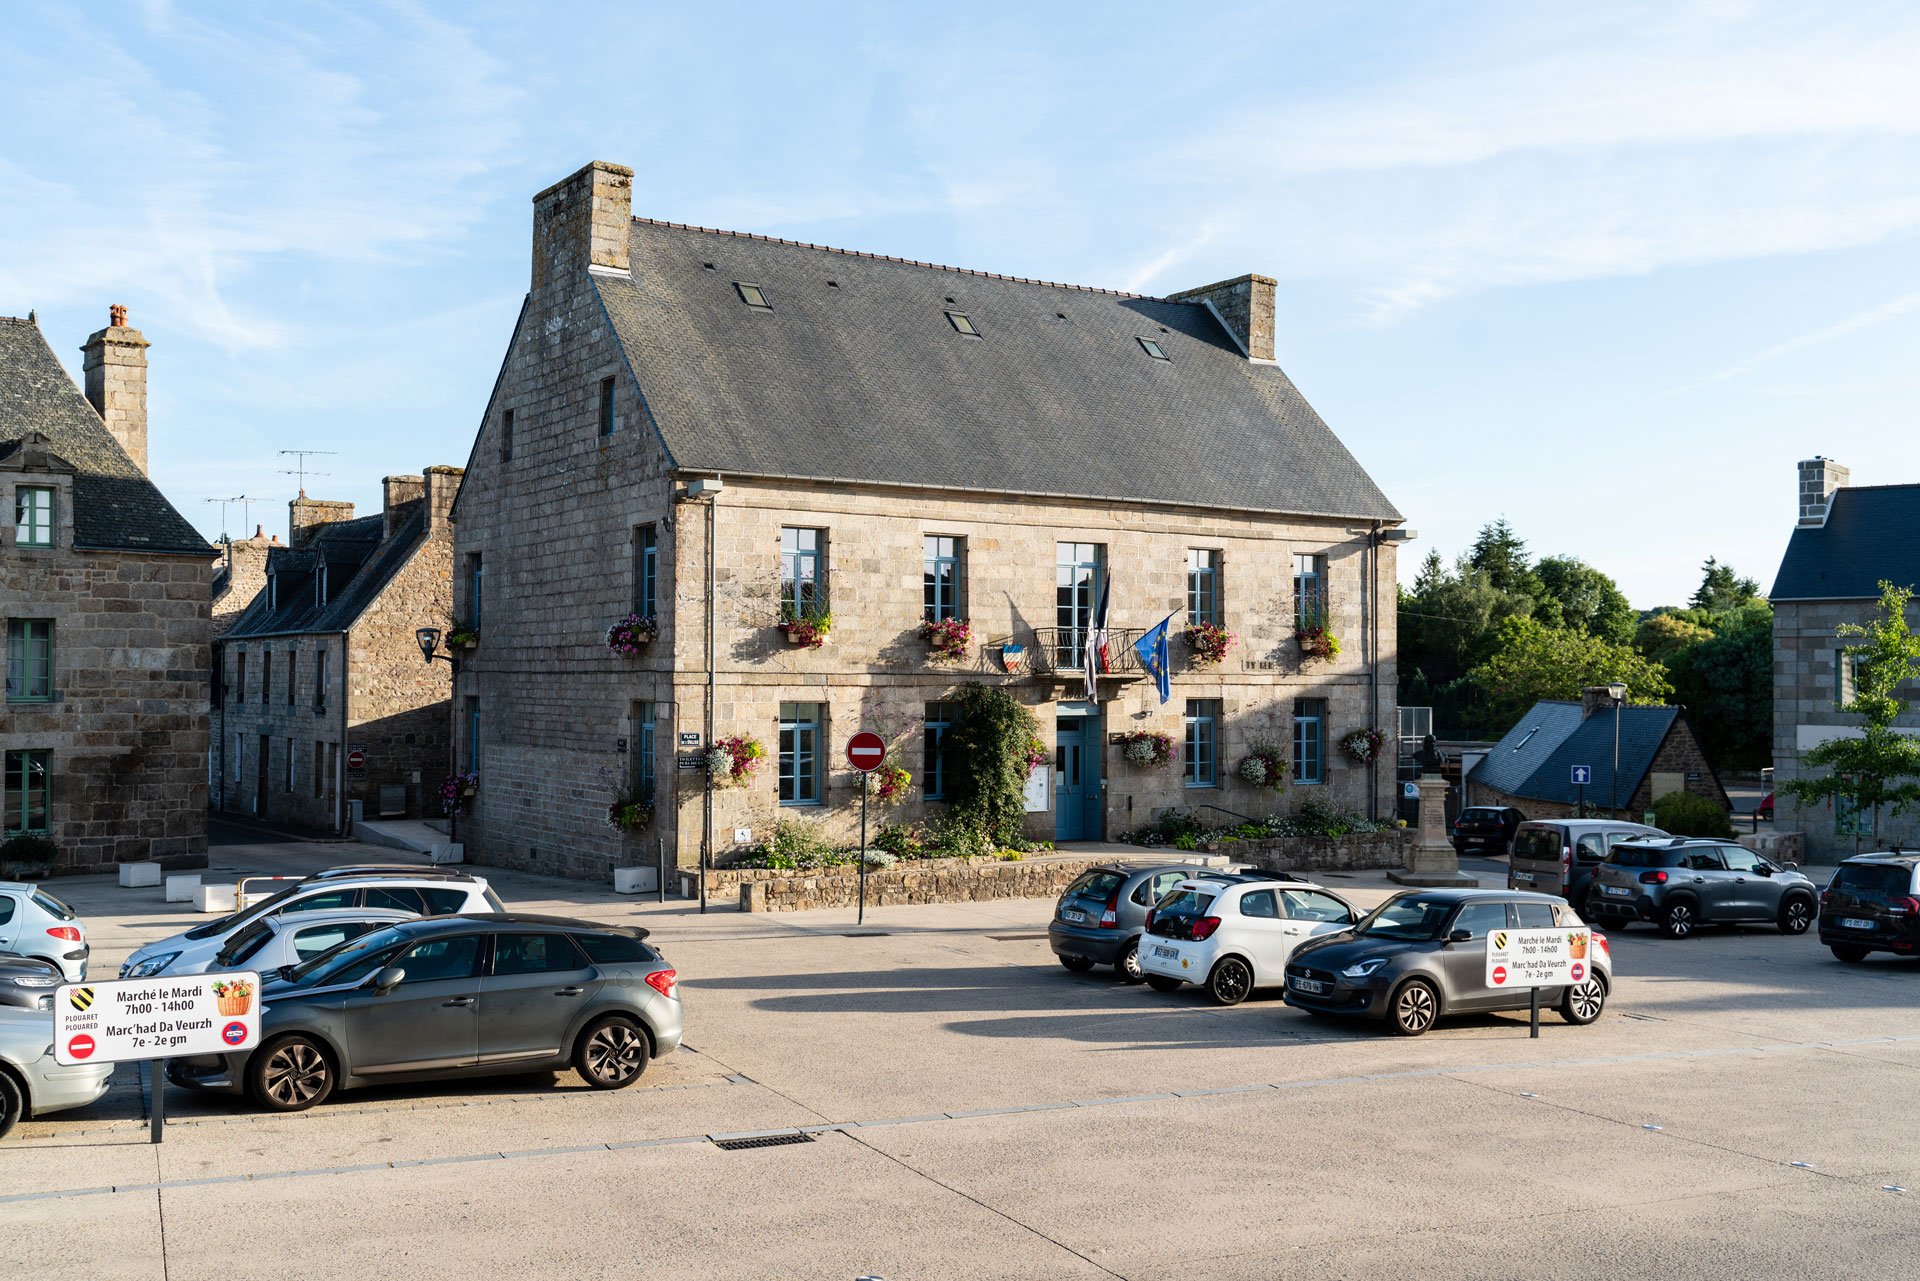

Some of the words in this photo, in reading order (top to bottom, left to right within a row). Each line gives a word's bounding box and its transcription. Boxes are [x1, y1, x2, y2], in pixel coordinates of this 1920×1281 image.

[1545, 971, 1553, 979] gm
[116, 989, 156, 1002] Marché
[160, 988, 168, 999] le
[172, 986, 202, 998] Mardi
[125, 1003, 152, 1015] 7h00
[162, 1000, 194, 1012] 14h00
[66, 1014, 98, 1022] PLOUARET
[66, 1022, 98, 1031] PLOUARED
[106, 1022, 156, 1036] Marc'had
[160, 1022, 173, 1032] Da
[176, 1018, 212, 1030] Veurzh
[132, 1038, 145, 1048] 7e
[154, 1036, 167, 1046] 2e
[170, 1035, 186, 1047] gm
